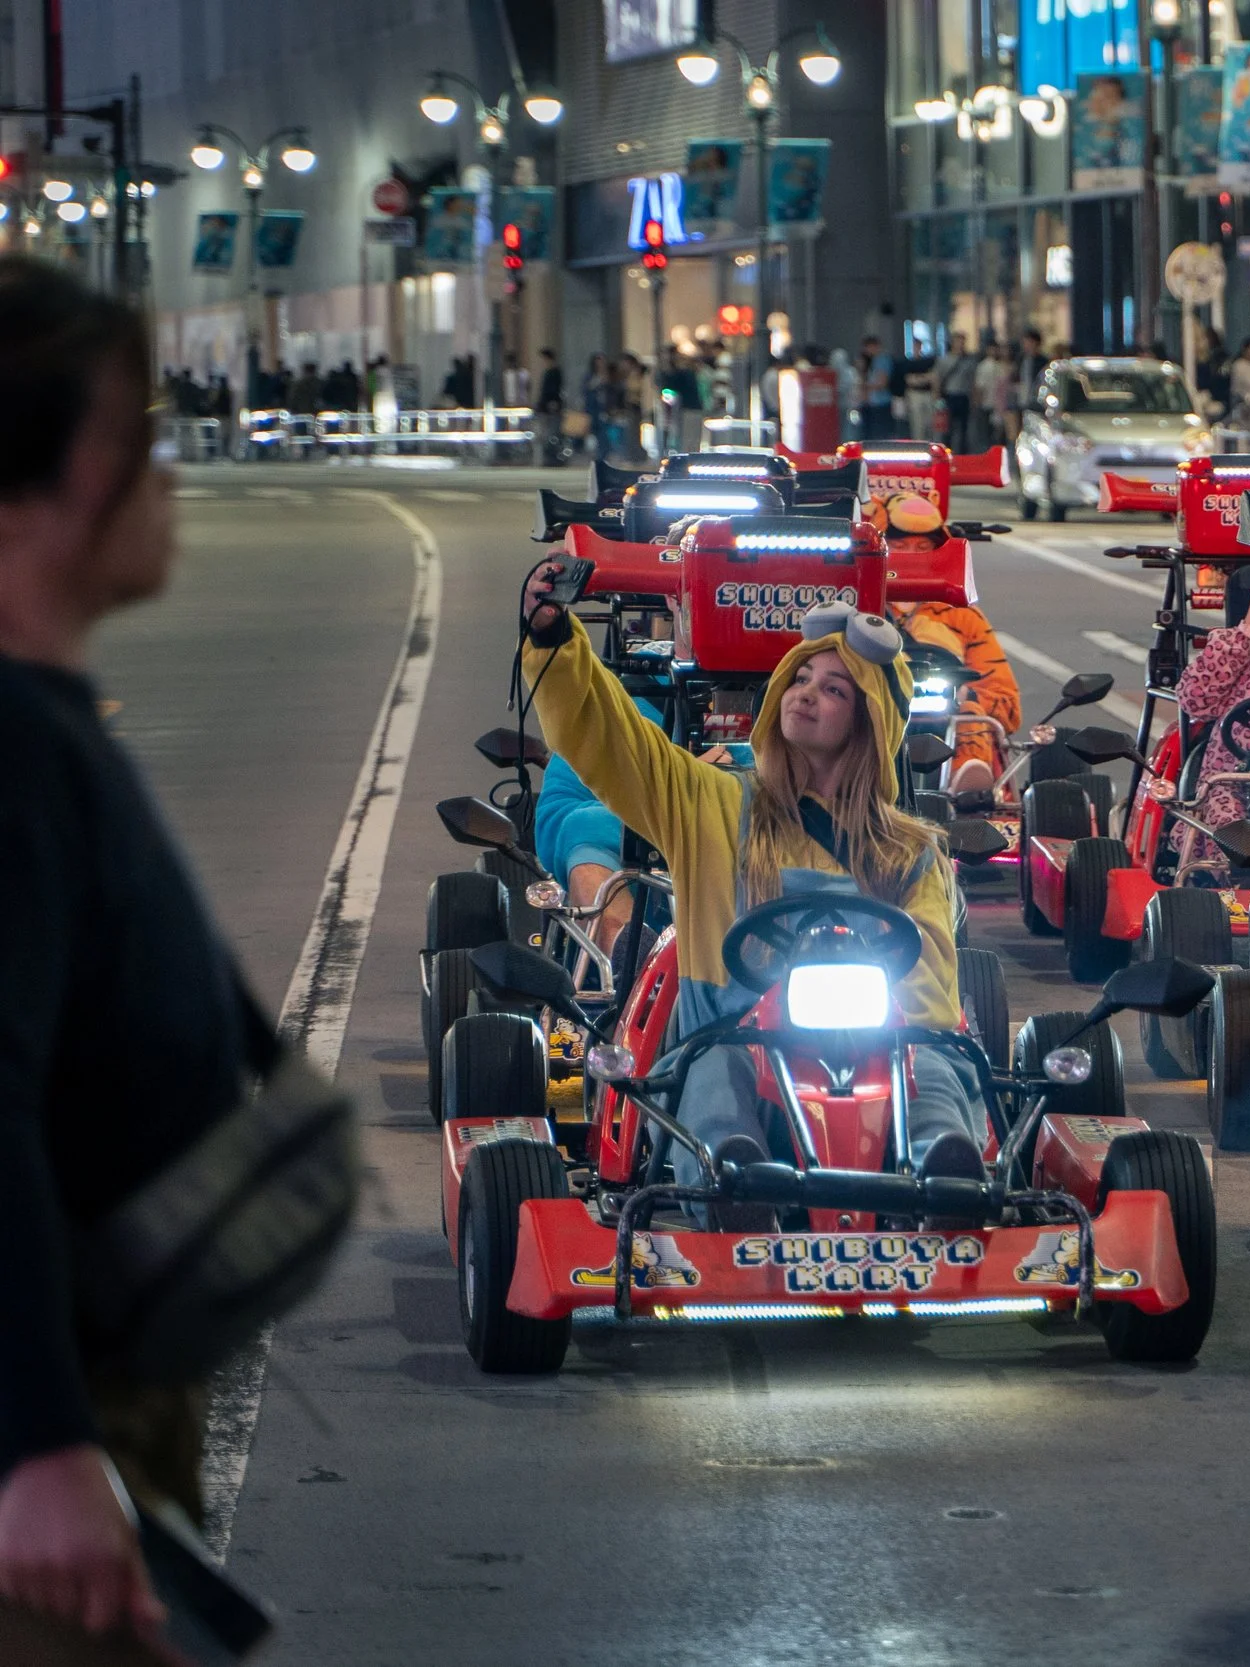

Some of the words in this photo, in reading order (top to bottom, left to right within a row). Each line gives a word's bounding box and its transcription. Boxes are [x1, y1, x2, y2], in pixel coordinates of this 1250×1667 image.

[626, 171, 705, 252] ZAR
[867, 474, 936, 492] HIBUYA
[715, 582, 859, 607] SHIBUYA
[743, 606, 803, 631] KAR
[733, 1235, 986, 1268] SHIBUYA
[783, 1263, 937, 1294] KART
